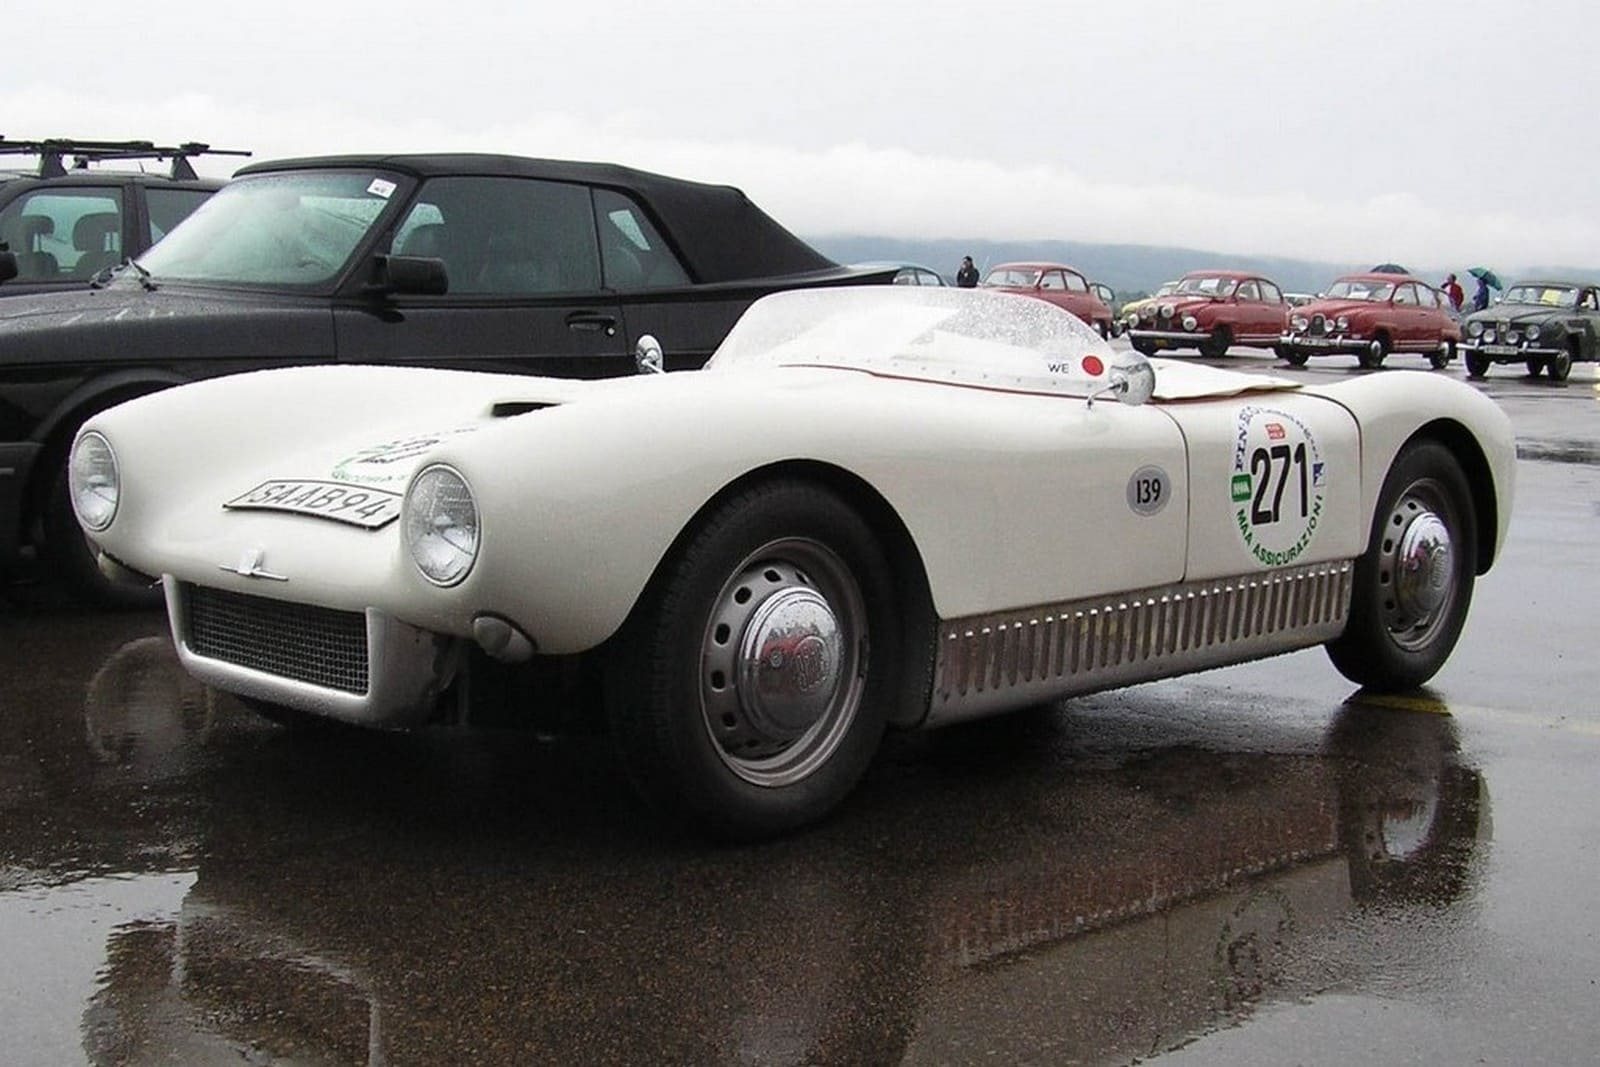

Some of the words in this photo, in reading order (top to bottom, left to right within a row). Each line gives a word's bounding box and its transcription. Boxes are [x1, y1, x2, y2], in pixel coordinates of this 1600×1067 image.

[1048, 363, 1069, 374] WE
[1136, 478, 1161, 504] 139
[1251, 443, 1308, 525] 271
[1237, 508, 1254, 546] MAA
[1252, 495, 1323, 566] ASSICURAZIONI
